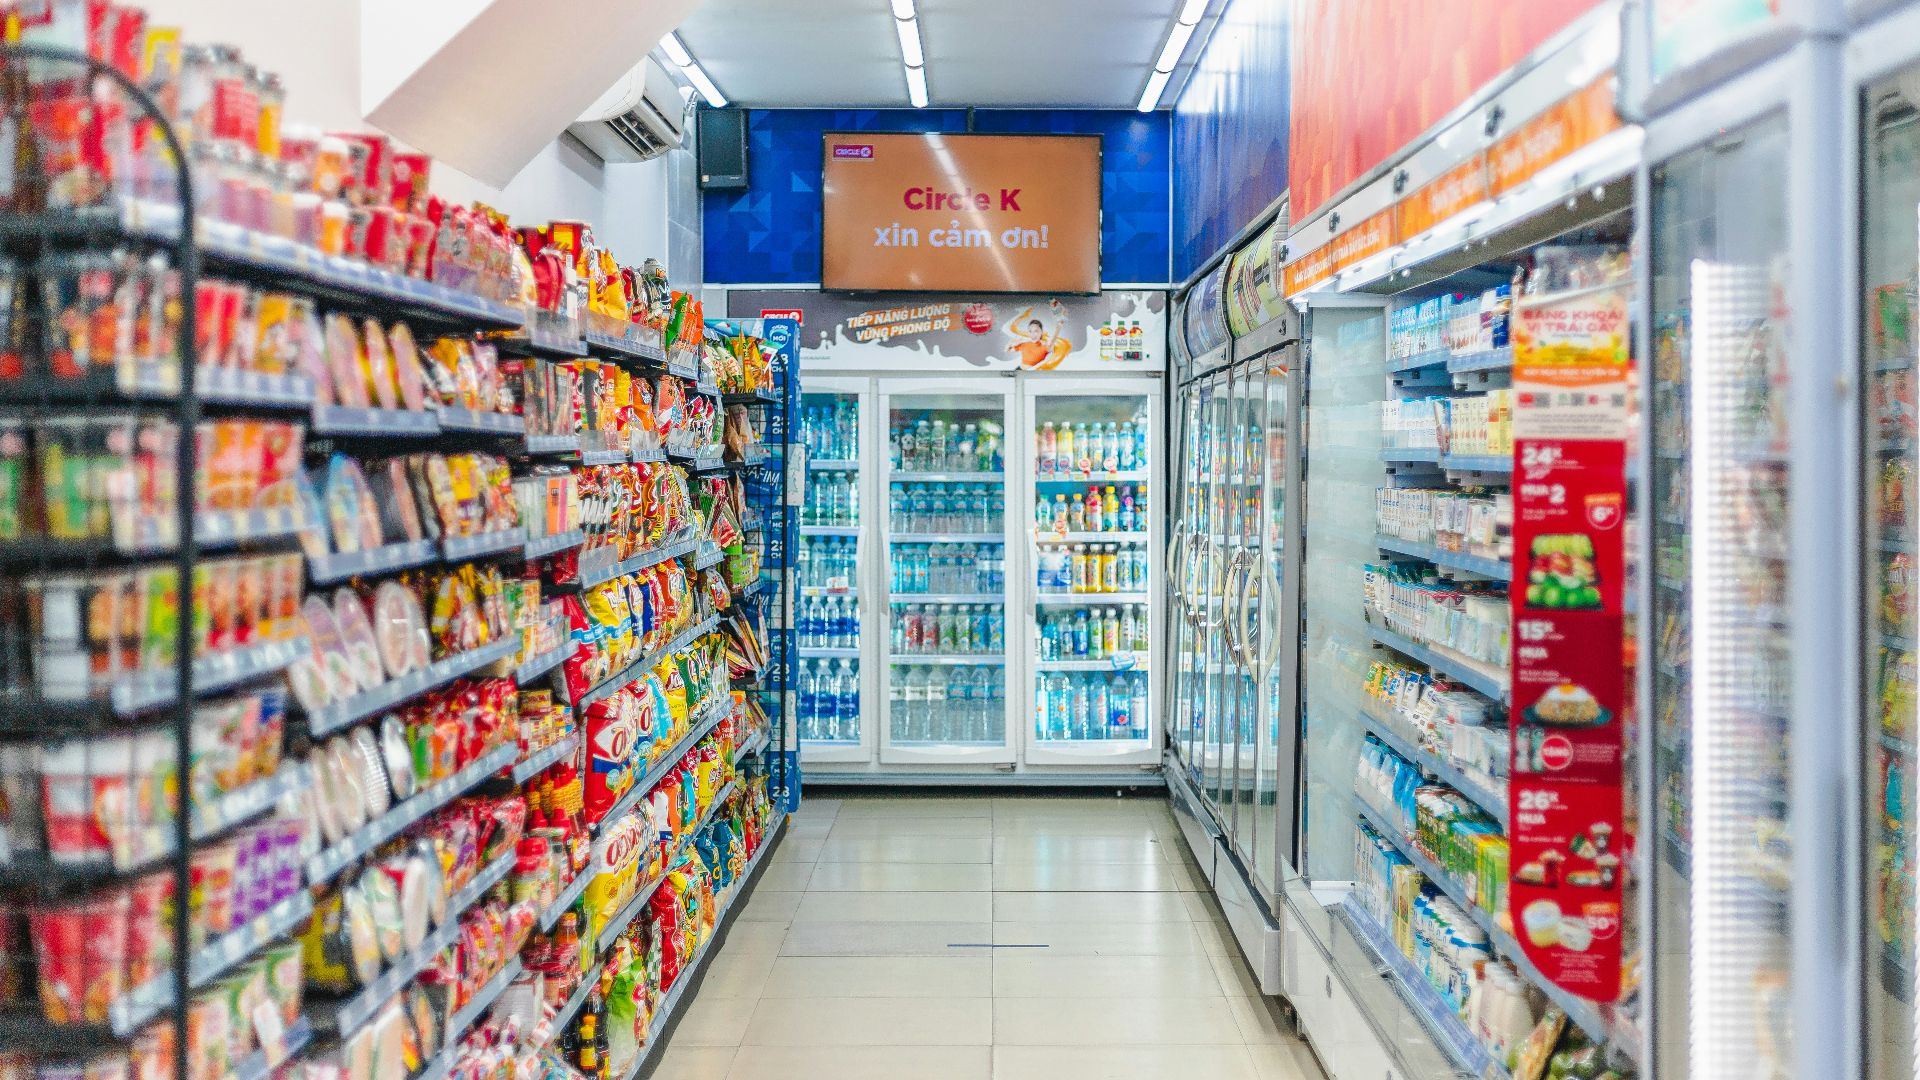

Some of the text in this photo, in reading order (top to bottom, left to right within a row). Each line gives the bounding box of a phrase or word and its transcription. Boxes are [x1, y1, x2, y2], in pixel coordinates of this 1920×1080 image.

[903, 186, 1022, 212] Circle K
[873, 219, 1049, 249] xin cảm ơn!
[847, 312, 873, 328] TIẾP
[874, 307, 908, 325] NĂNG
[890, 320, 931, 337] PHONG
[933, 316, 951, 332] ĐỘ
[1550, 484, 1566, 504] 2
